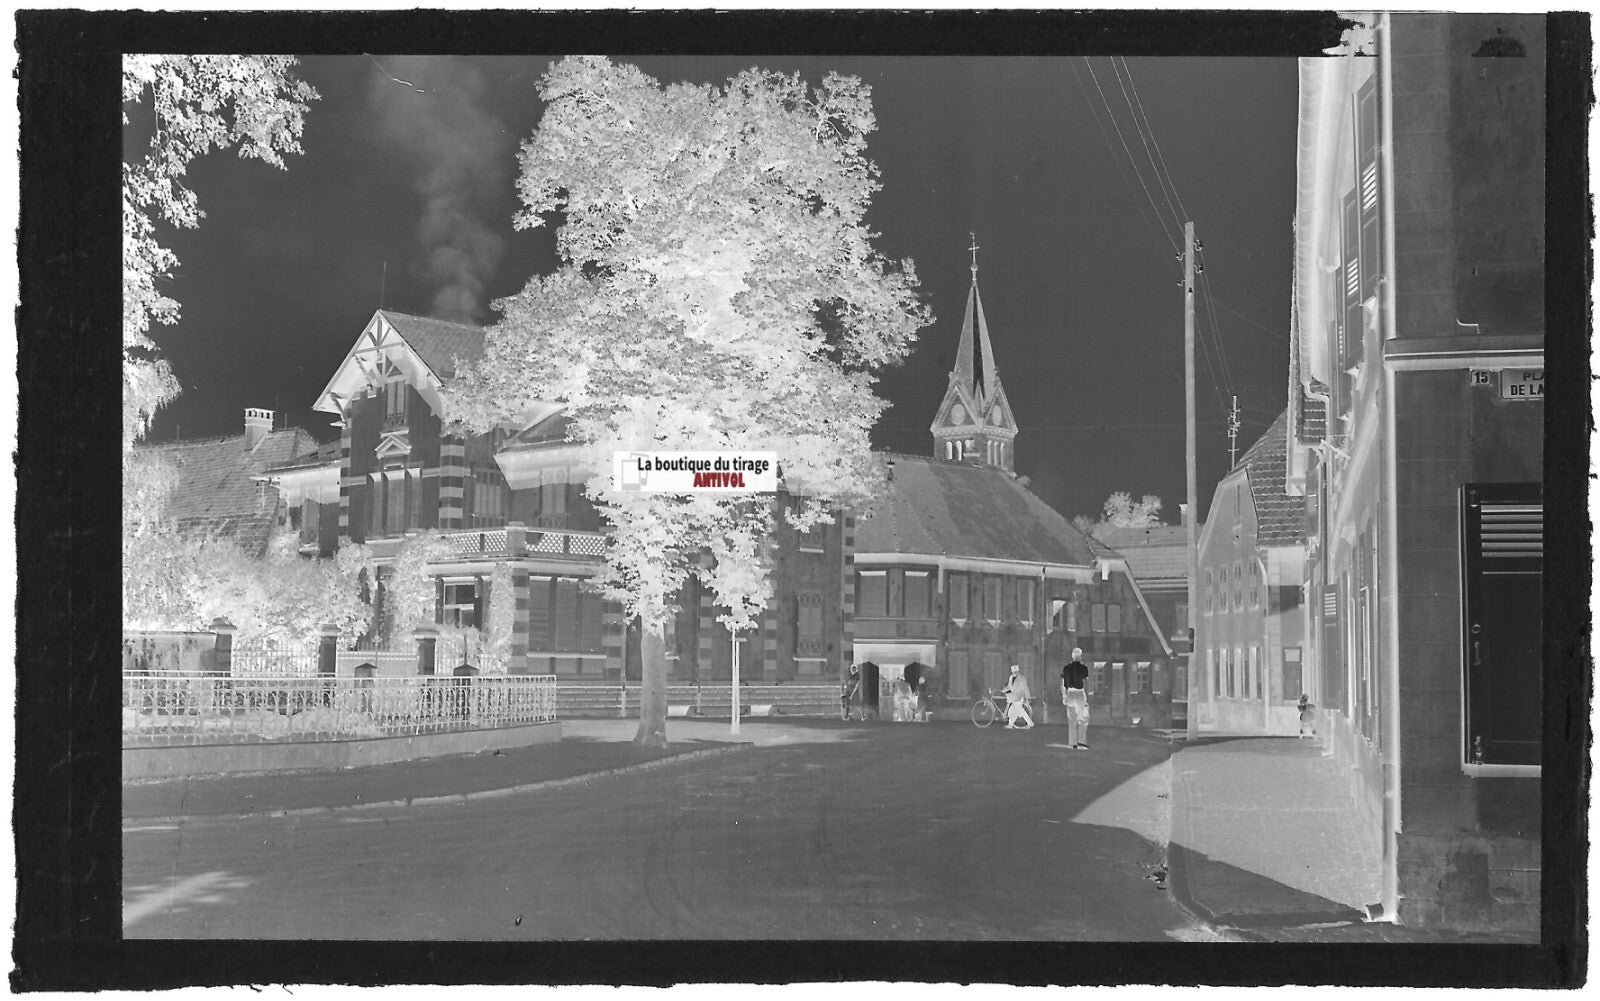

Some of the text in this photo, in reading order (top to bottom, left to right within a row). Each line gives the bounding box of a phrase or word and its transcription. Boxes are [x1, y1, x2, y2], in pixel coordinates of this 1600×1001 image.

[1475, 371, 1489, 384] 15
[1510, 384, 1544, 395] DE LA
